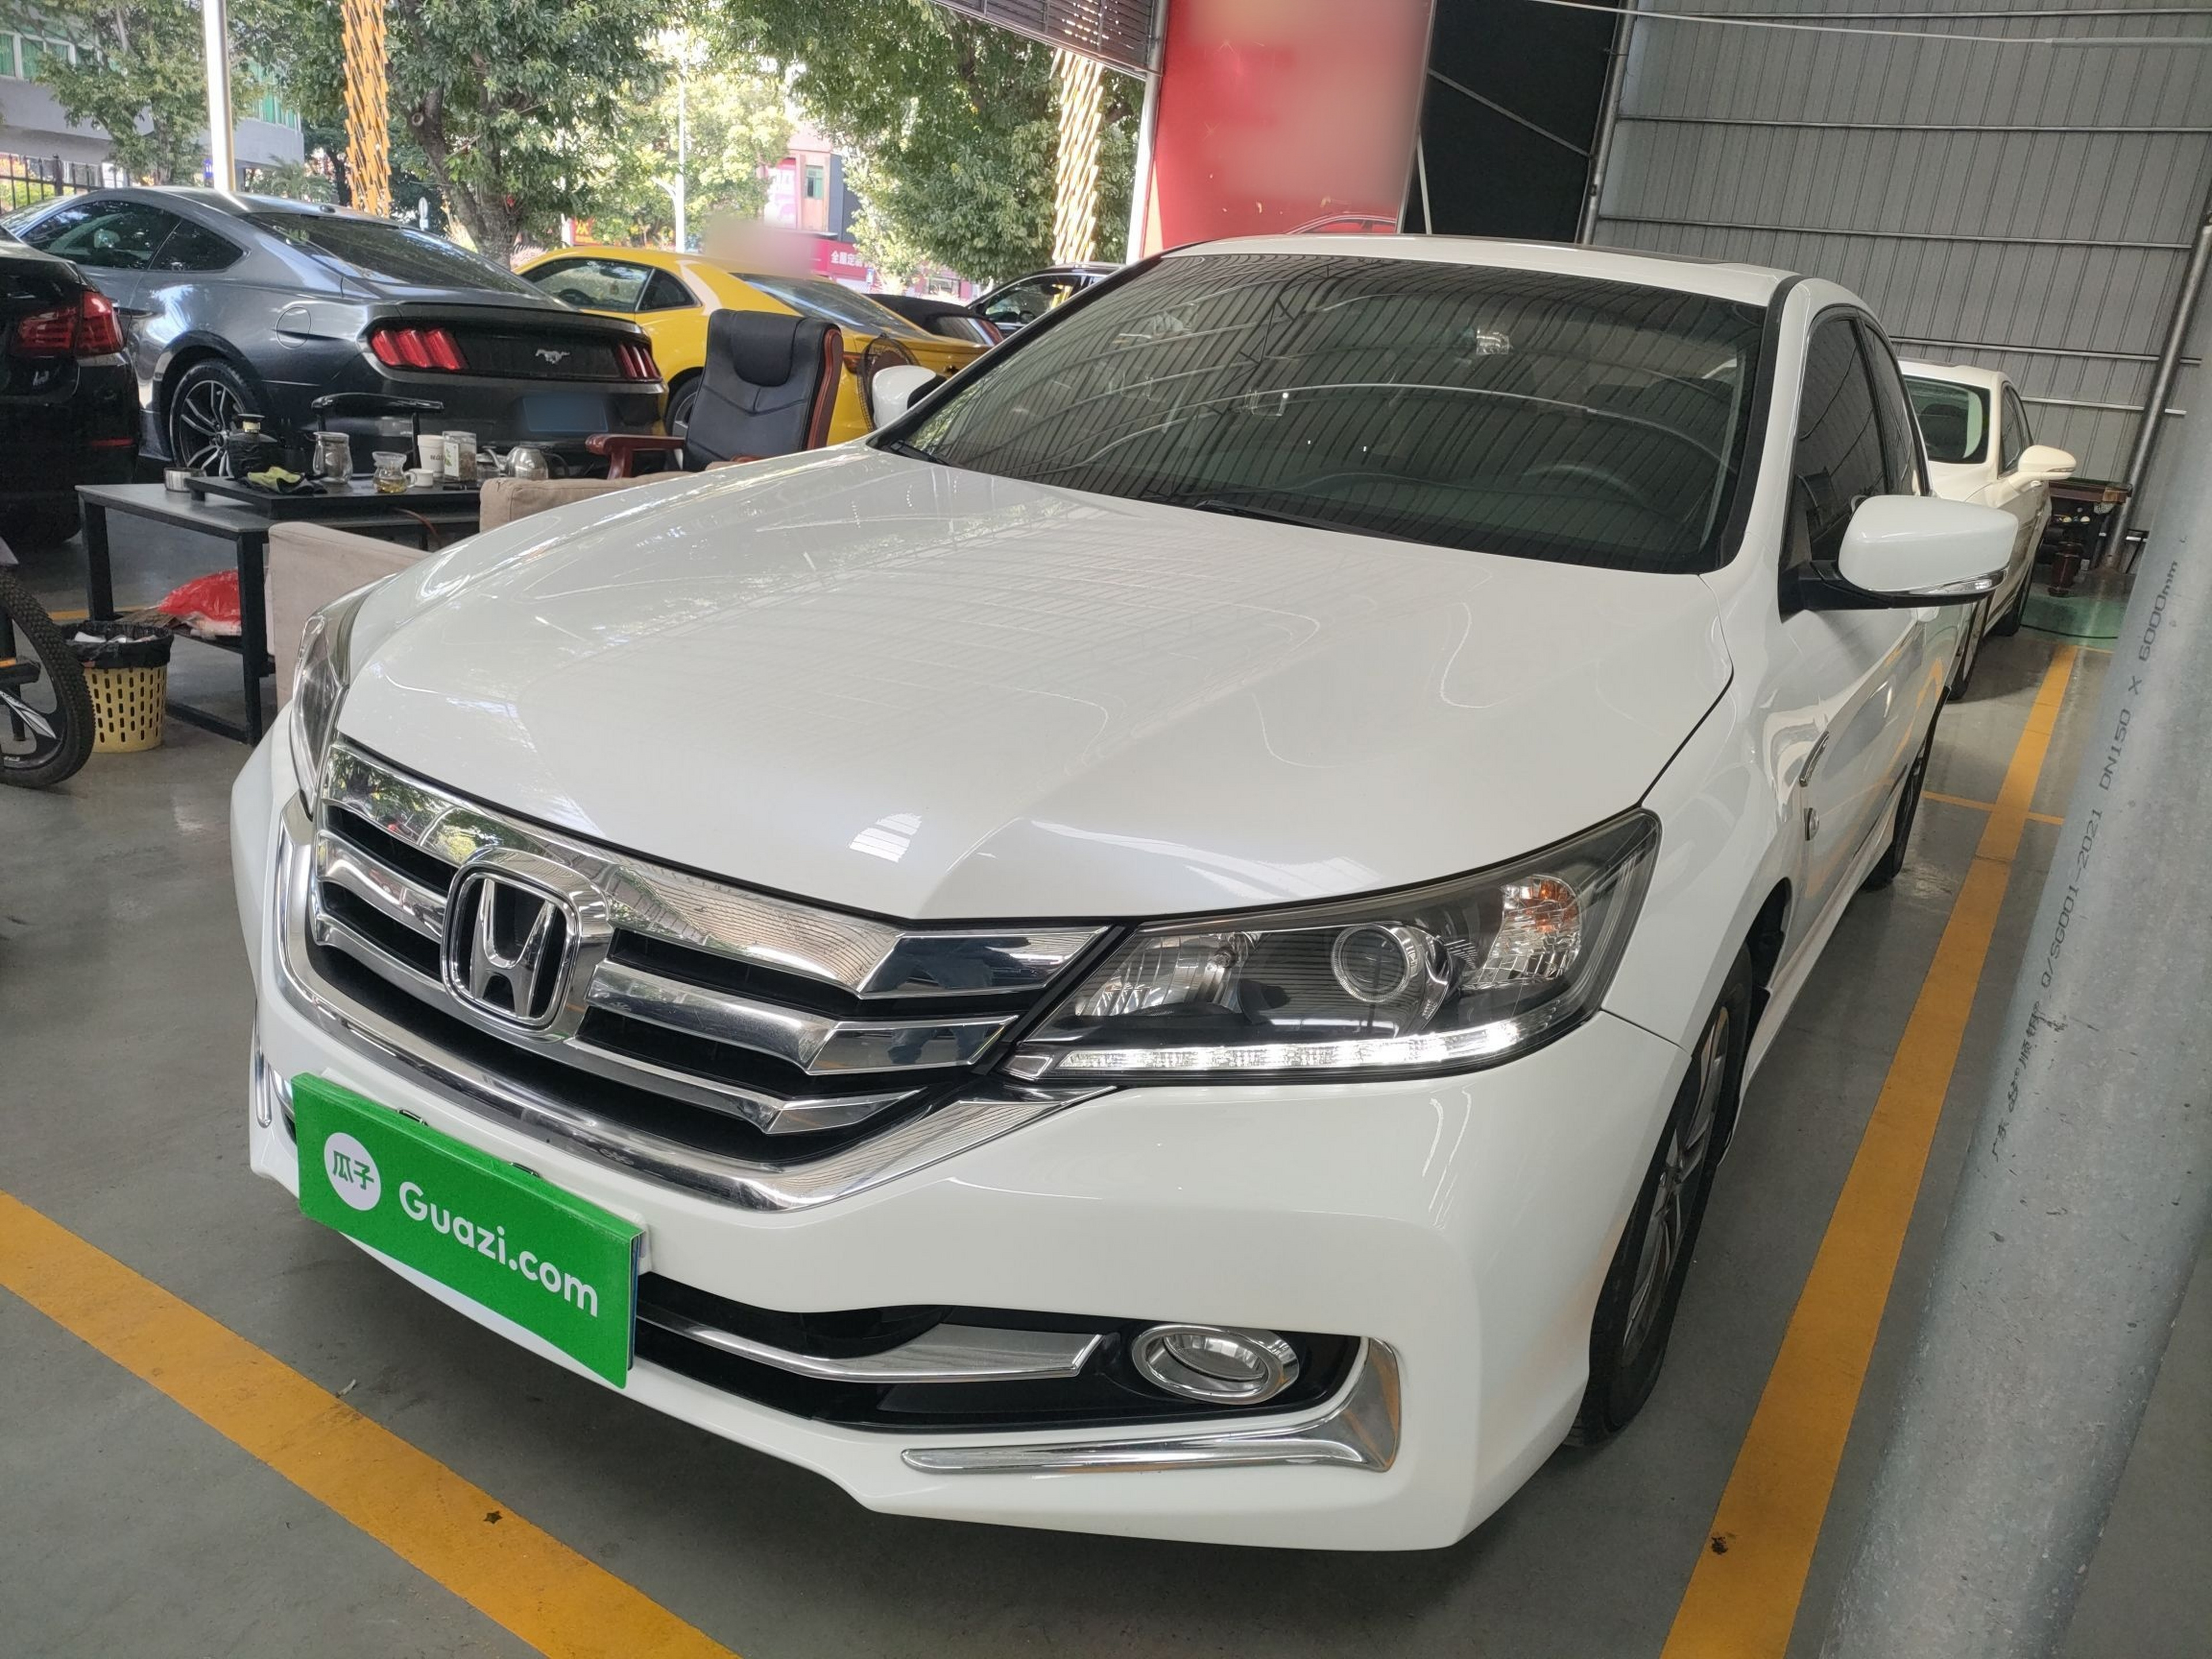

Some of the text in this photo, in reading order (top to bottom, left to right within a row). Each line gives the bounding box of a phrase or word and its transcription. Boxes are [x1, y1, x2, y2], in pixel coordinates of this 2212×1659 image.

[2099, 708, 2131, 791] DN150
[2138, 560, 2177, 662] 6000mm
[332, 1150, 375, 1191] 瓜子
[399, 1181, 598, 1318] Guazi.com
